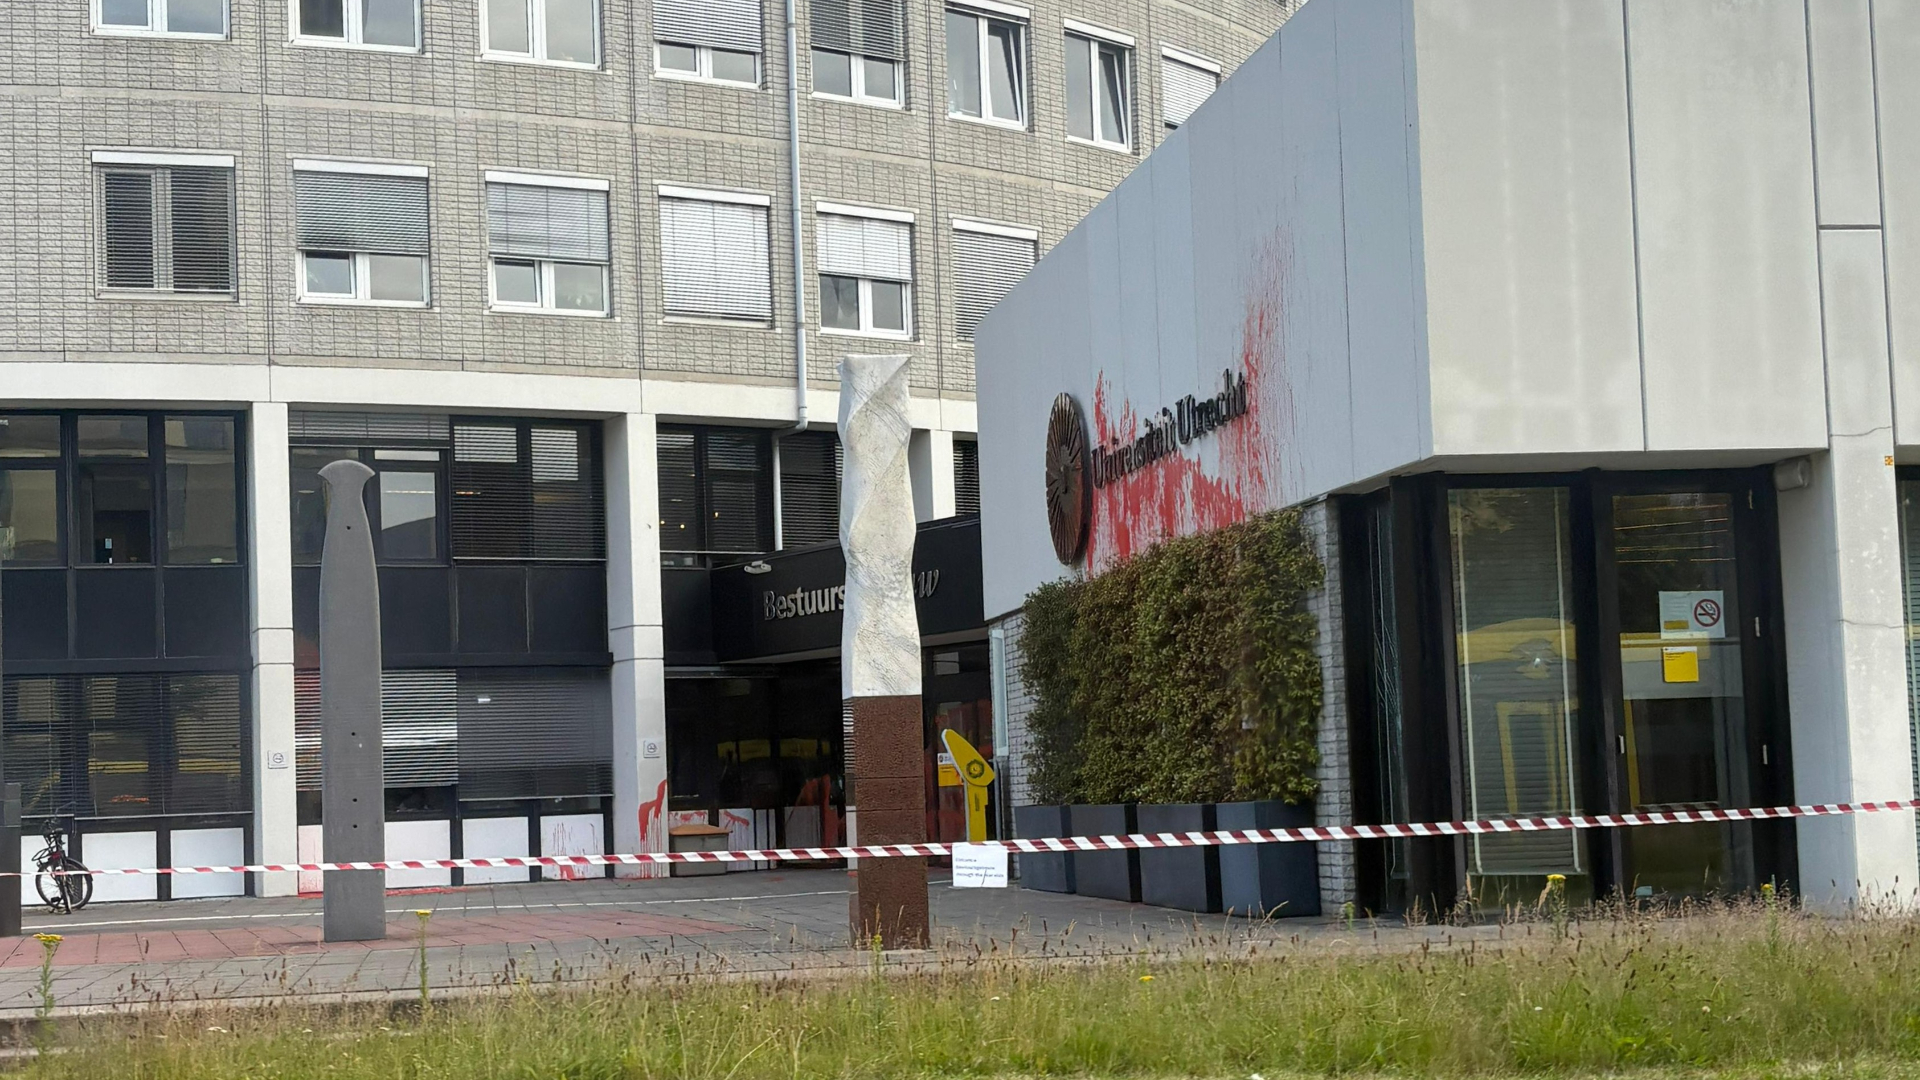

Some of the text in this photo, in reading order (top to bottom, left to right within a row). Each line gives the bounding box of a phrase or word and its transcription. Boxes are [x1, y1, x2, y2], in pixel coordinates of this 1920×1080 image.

[1092, 369, 1247, 488] Universiteit Utrecht
[764, 569, 939, 620] Bestuursw
